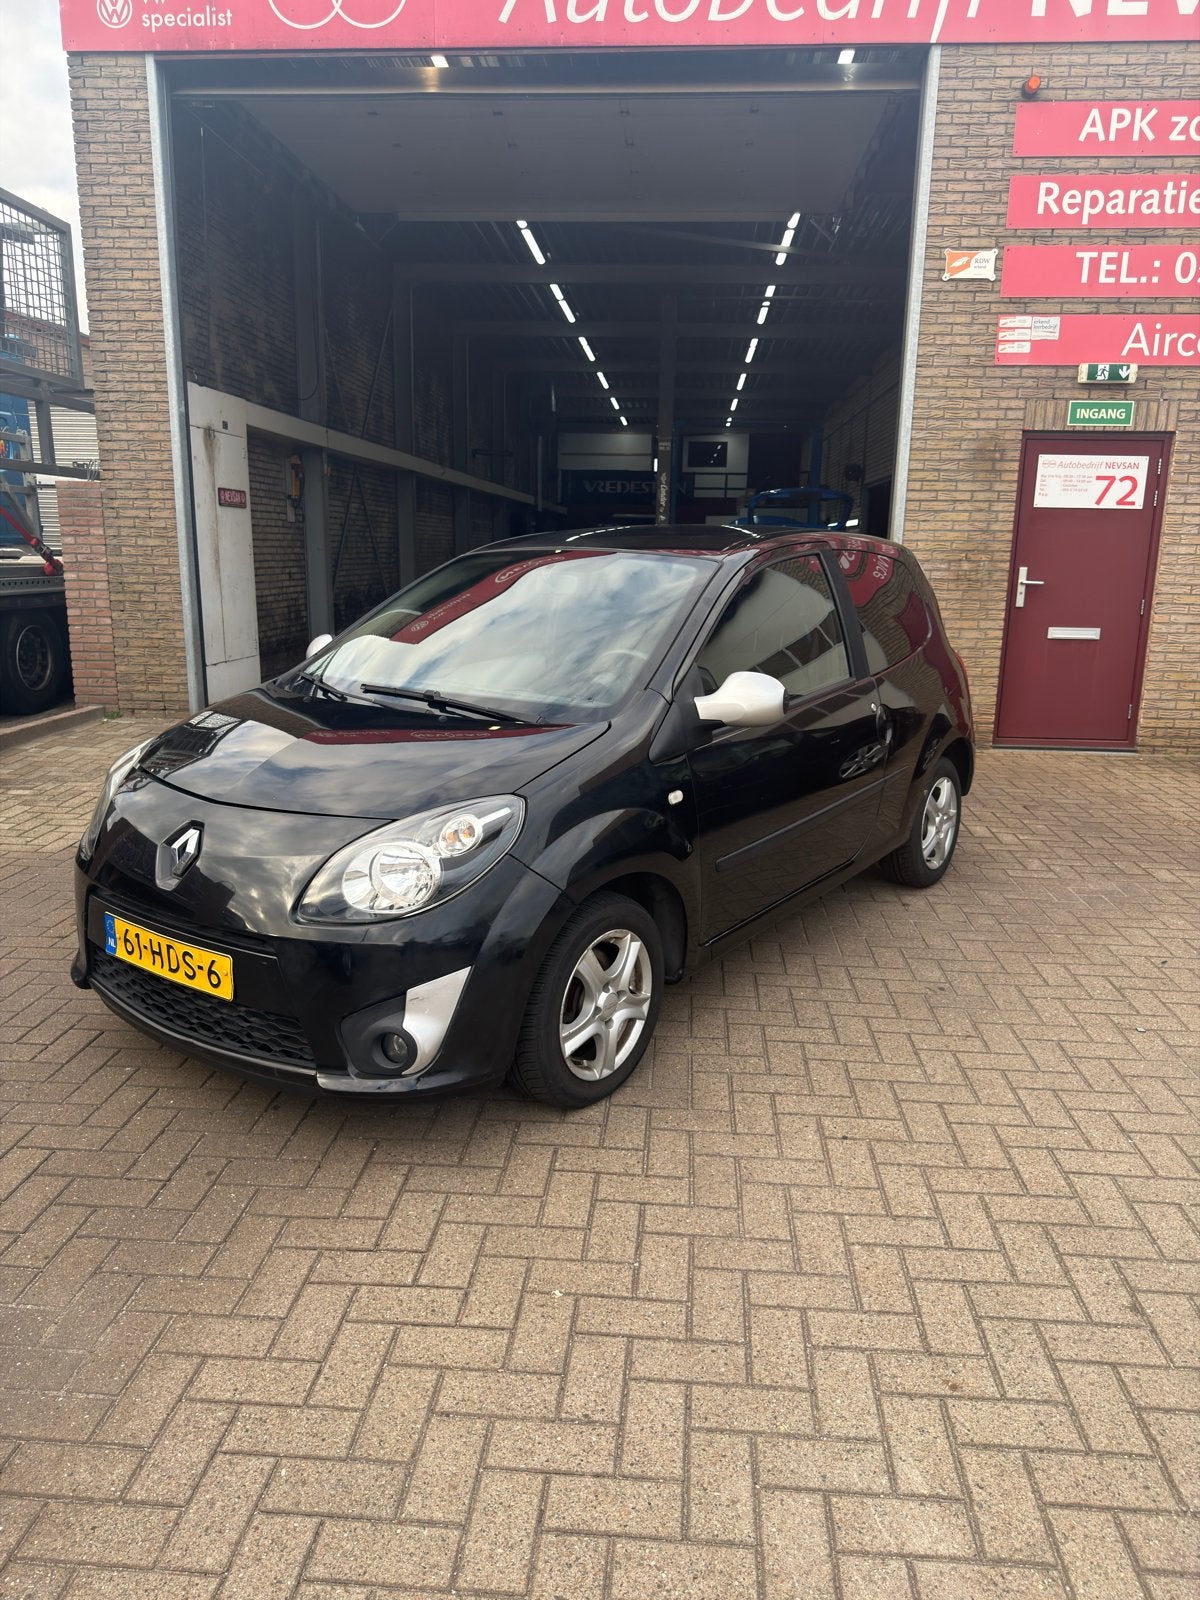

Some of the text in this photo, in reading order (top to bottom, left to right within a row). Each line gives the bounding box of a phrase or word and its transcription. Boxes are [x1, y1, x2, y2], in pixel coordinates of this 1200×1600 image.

[142, 5, 232, 33] specialist
[1078, 107, 1159, 142] APK
[1075, 251, 1200, 284] TEL.: 0
[1120, 322, 1200, 357] Airc
[1076, 408, 1126, 419] INGANG
[1057, 460, 1140, 471] Autobedrijf NEVSAN
[583, 480, 688, 494] VREDESTN
[1094, 475, 1138, 506] 72
[108, 936, 116, 948] NL
[123, 928, 222, 989] 61-HDS-6
